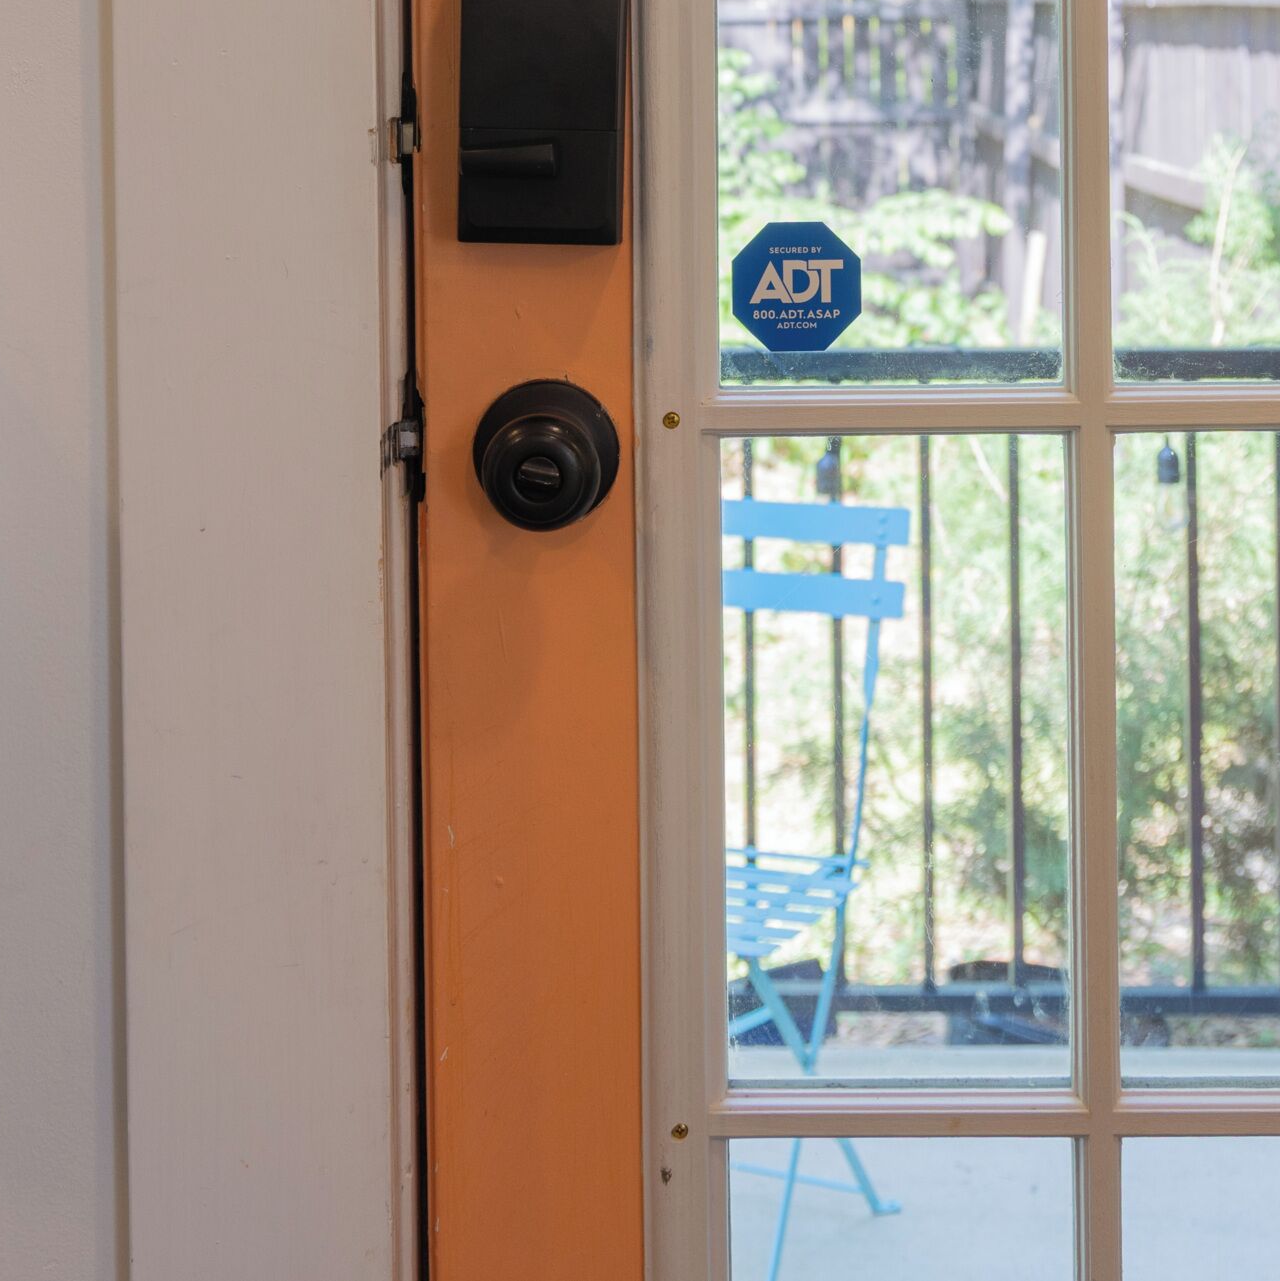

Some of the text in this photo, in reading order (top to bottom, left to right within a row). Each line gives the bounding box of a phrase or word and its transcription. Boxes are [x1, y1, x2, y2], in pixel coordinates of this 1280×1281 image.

[768, 246, 822, 254] SECURED BY
[749, 259, 844, 305] ADT
[753, 309, 841, 320] 800.ADT.ASAP
[776, 321, 817, 329] ADT.COM
